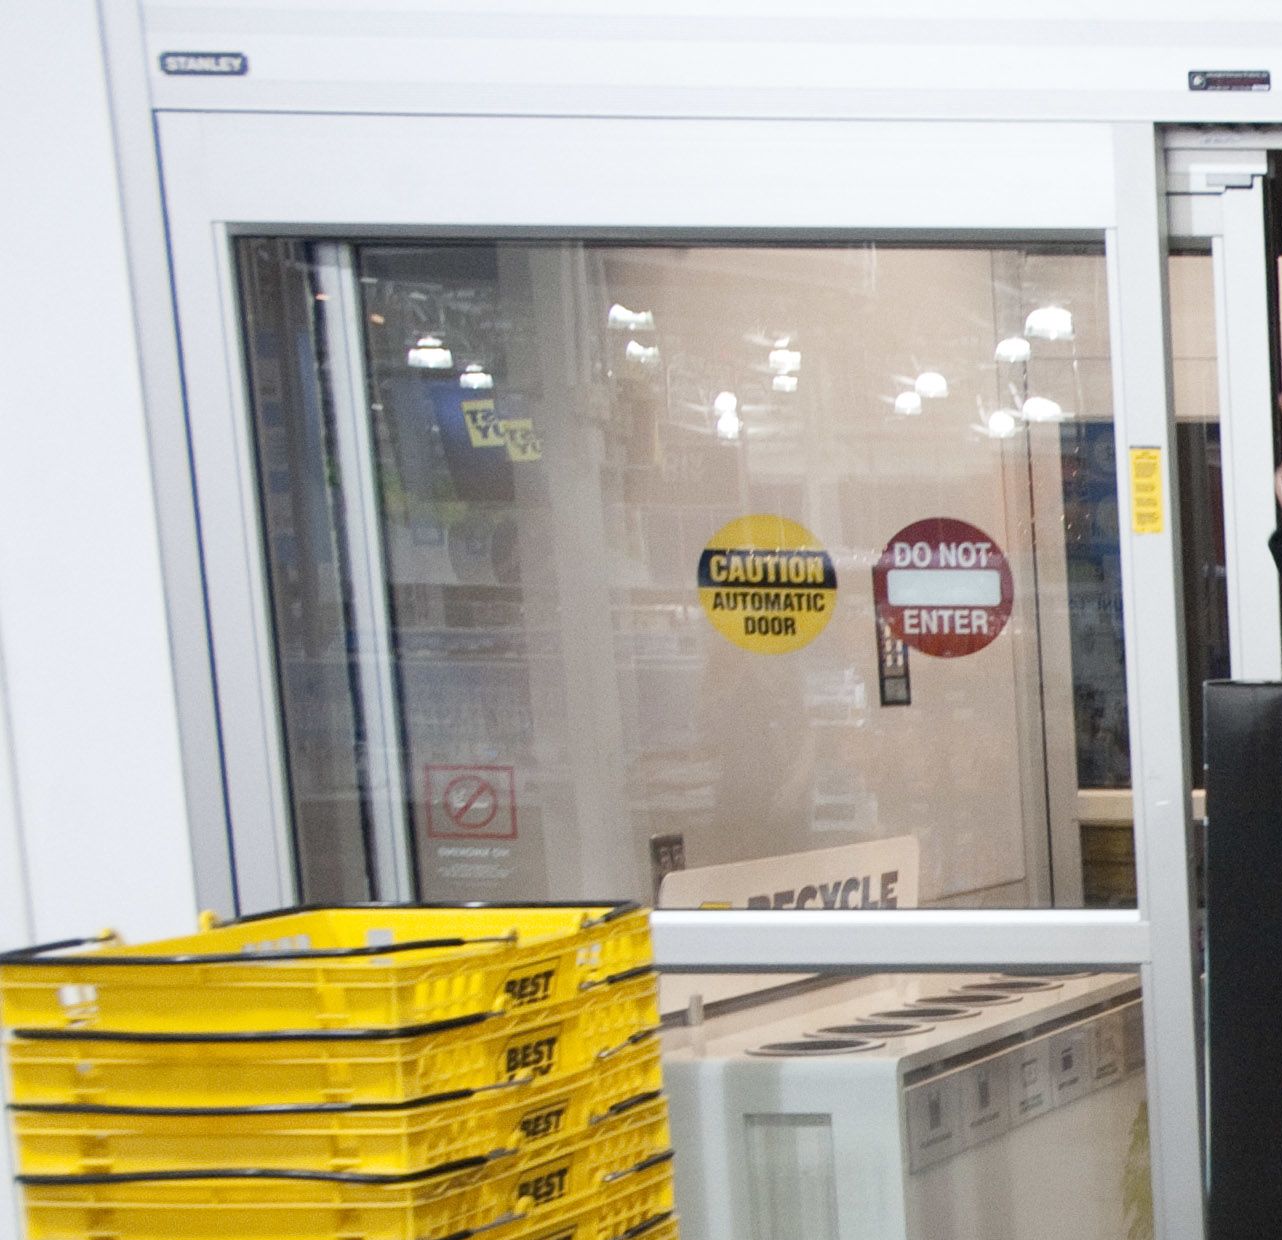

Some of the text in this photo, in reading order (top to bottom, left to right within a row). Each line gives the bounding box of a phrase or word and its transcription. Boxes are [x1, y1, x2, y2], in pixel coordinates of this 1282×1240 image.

[165, 56, 242, 72] STANLEY
[894, 542, 992, 568] DO NOT
[709, 556, 825, 584] CAUTION
[712, 592, 825, 612] AUTOMATIC
[744, 616, 796, 636] DOOR
[903, 609, 989, 635] ENTER
[505, 969, 553, 997] BEST
[506, 1037, 556, 1072] BEST
[521, 1109, 563, 1137] BEST
